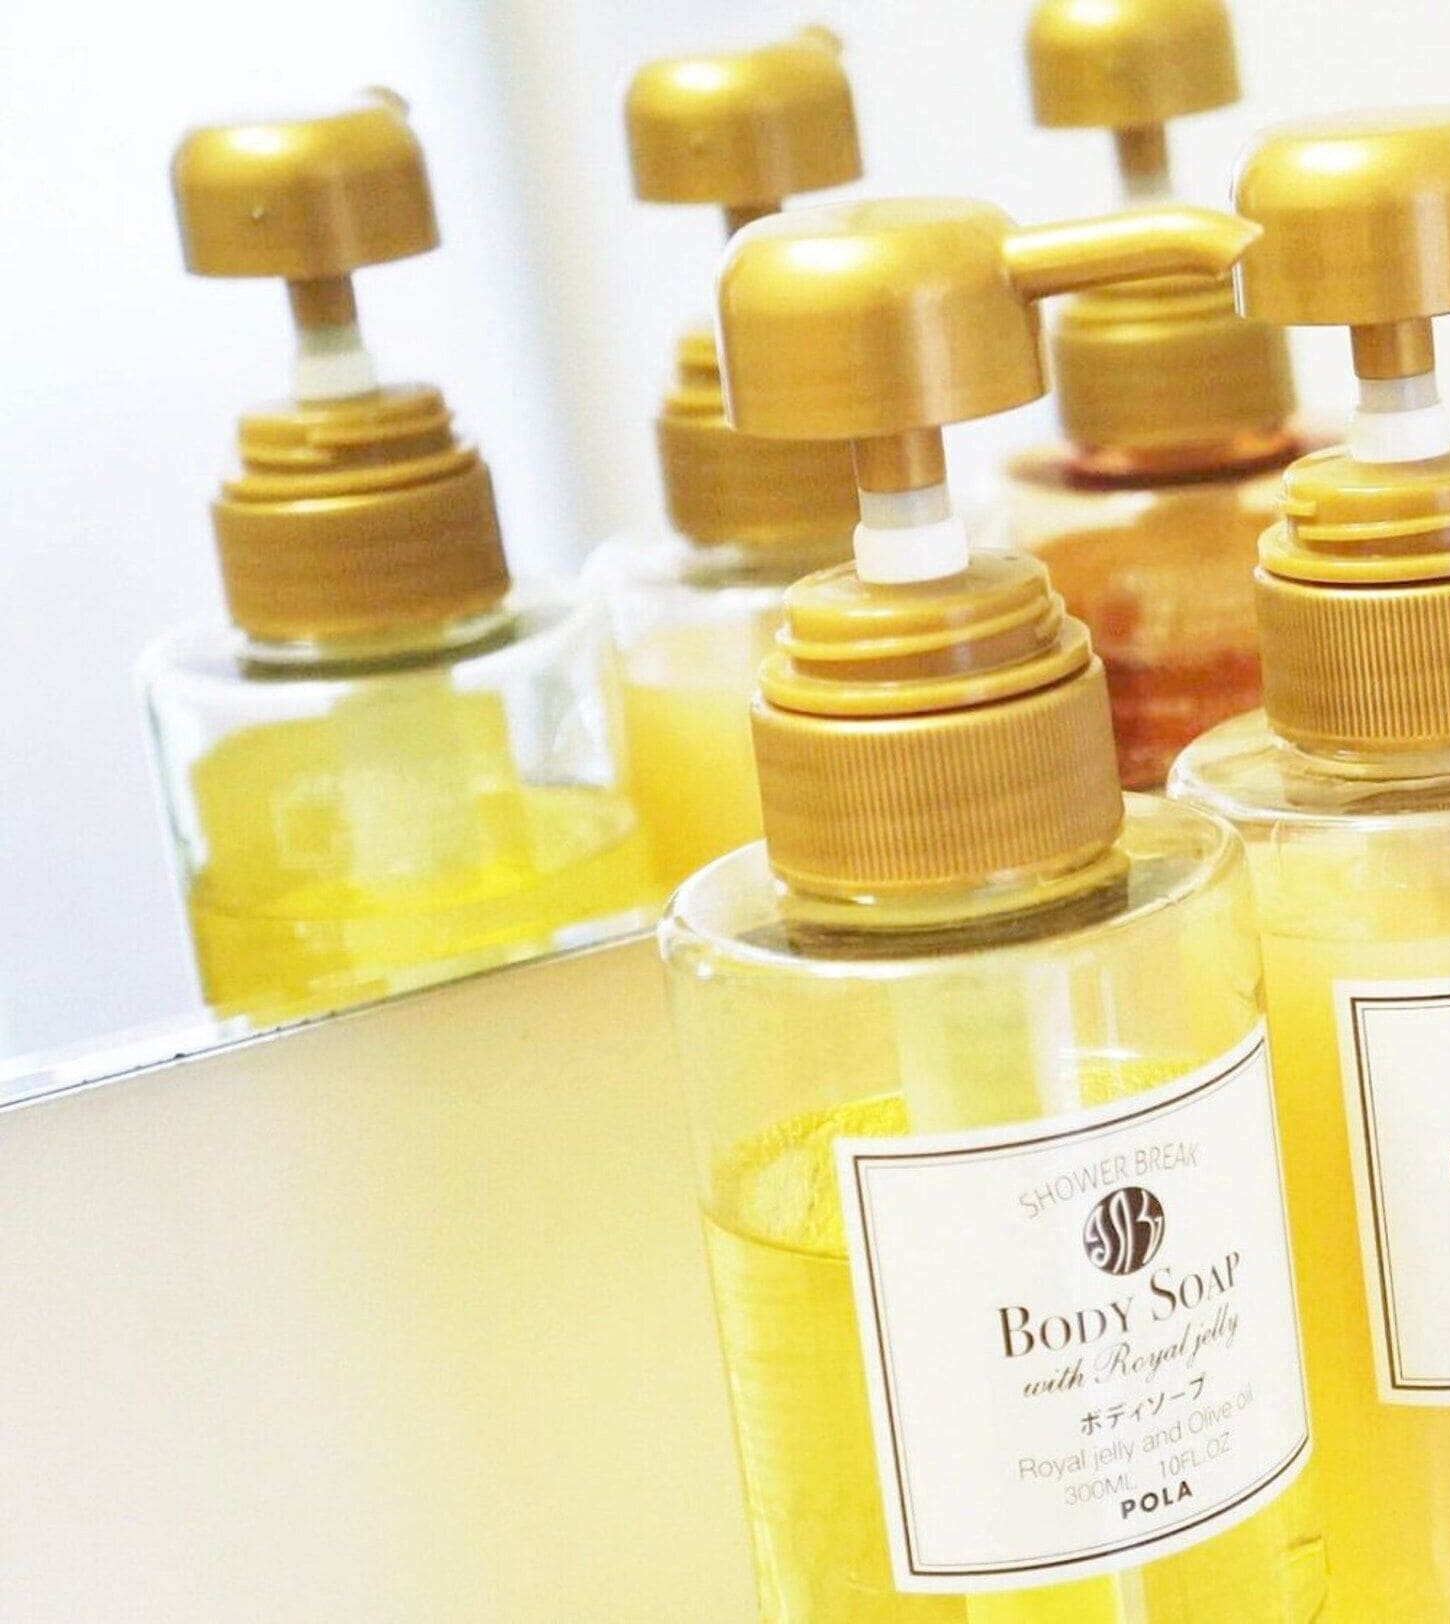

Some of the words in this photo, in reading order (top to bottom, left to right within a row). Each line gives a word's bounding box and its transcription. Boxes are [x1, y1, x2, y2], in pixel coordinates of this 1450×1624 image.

[1019, 1154, 1127, 1218] SHOWER
[1134, 1141, 1198, 1176] BREAK
[998, 1297, 1133, 1358] BODY
[1149, 1251, 1241, 1322] SOAP
[1023, 1359, 1085, 1397] with
[1095, 1330, 1190, 1384] Royal
[1192, 1302, 1240, 1358] jelly
[1019, 1448, 1087, 1483] Royal
[1093, 1439, 1134, 1469] jelly
[1142, 1421, 1182, 1453] and
[1188, 1401, 1235, 1433] Olive
[1235, 1382, 1254, 1412] oil
[1080, 1373, 1206, 1437] ボディソープ
[1121, 1480, 1193, 1519] POLA
